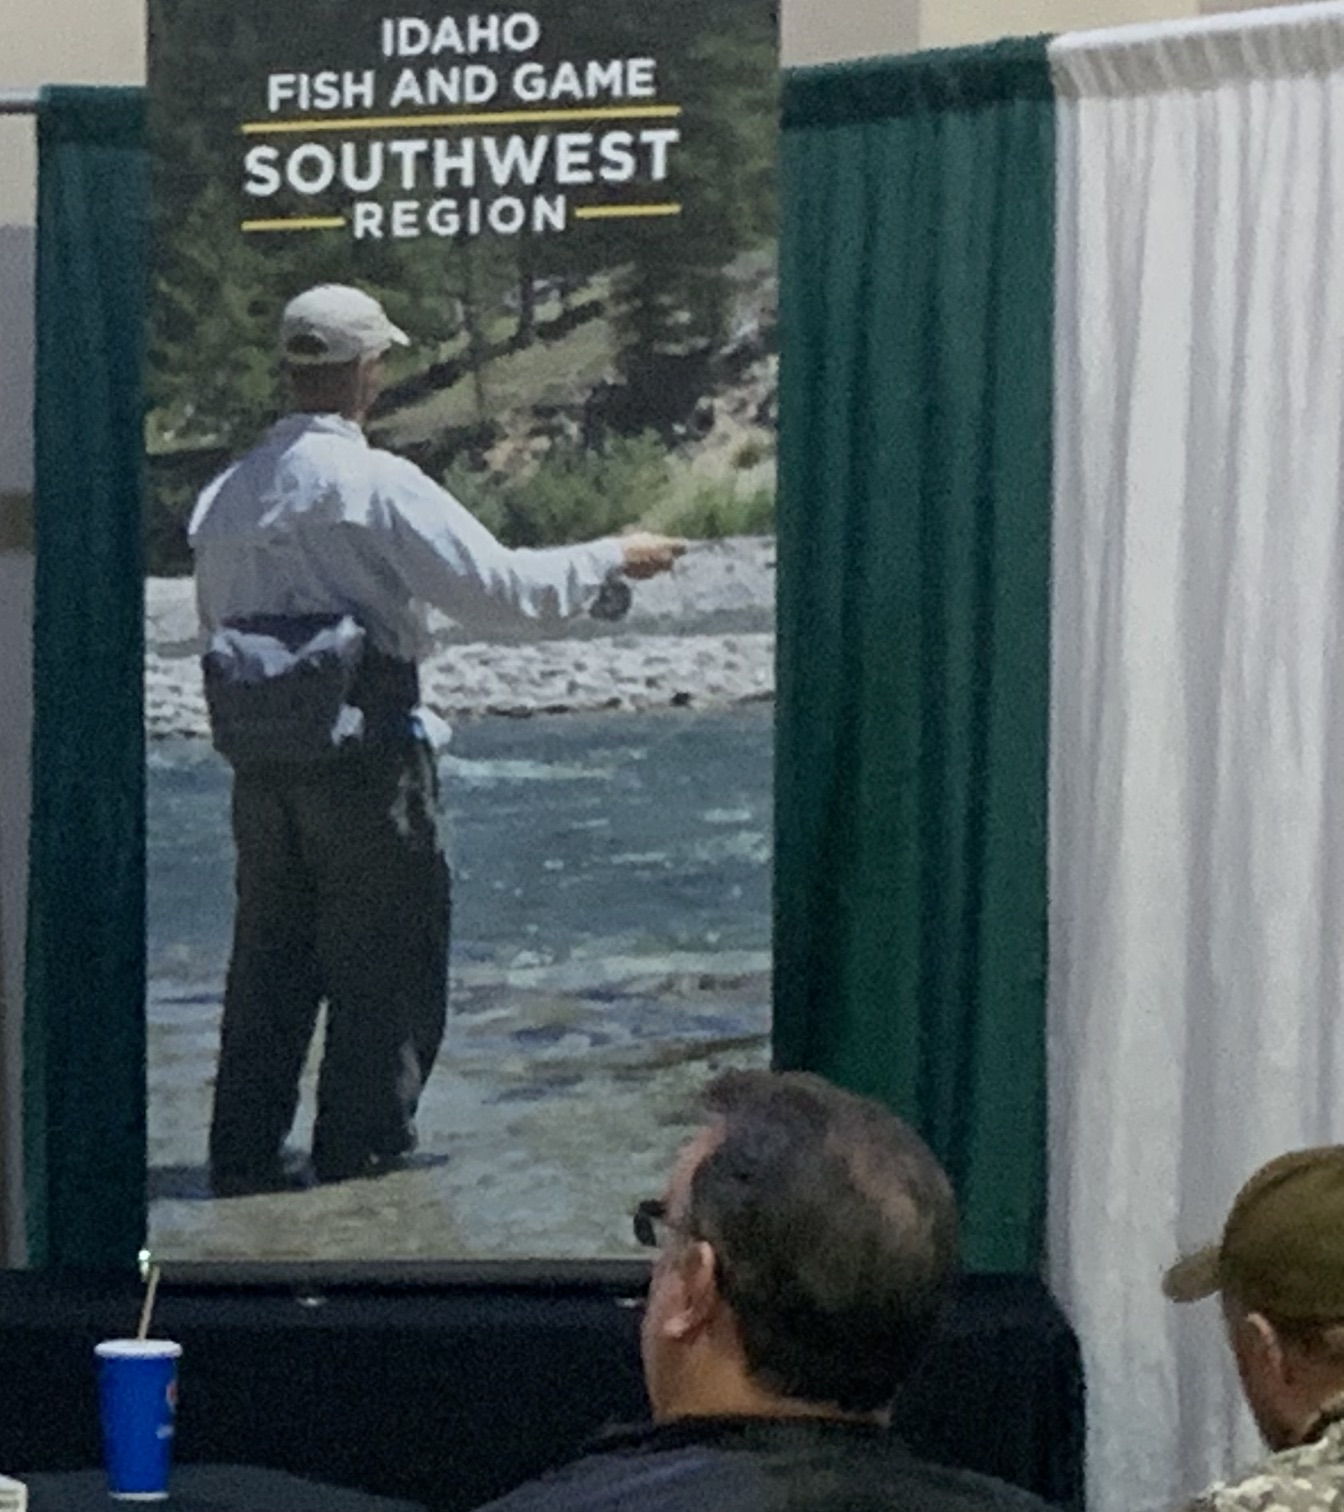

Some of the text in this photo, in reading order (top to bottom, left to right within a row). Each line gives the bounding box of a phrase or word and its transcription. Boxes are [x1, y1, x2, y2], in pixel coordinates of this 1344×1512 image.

[381, 11, 540, 57] IDAHO
[268, 57, 657, 113] FISH AND GAME
[243, 128, 680, 197] SOUTHWEST
[352, 195, 566, 240] REGION
